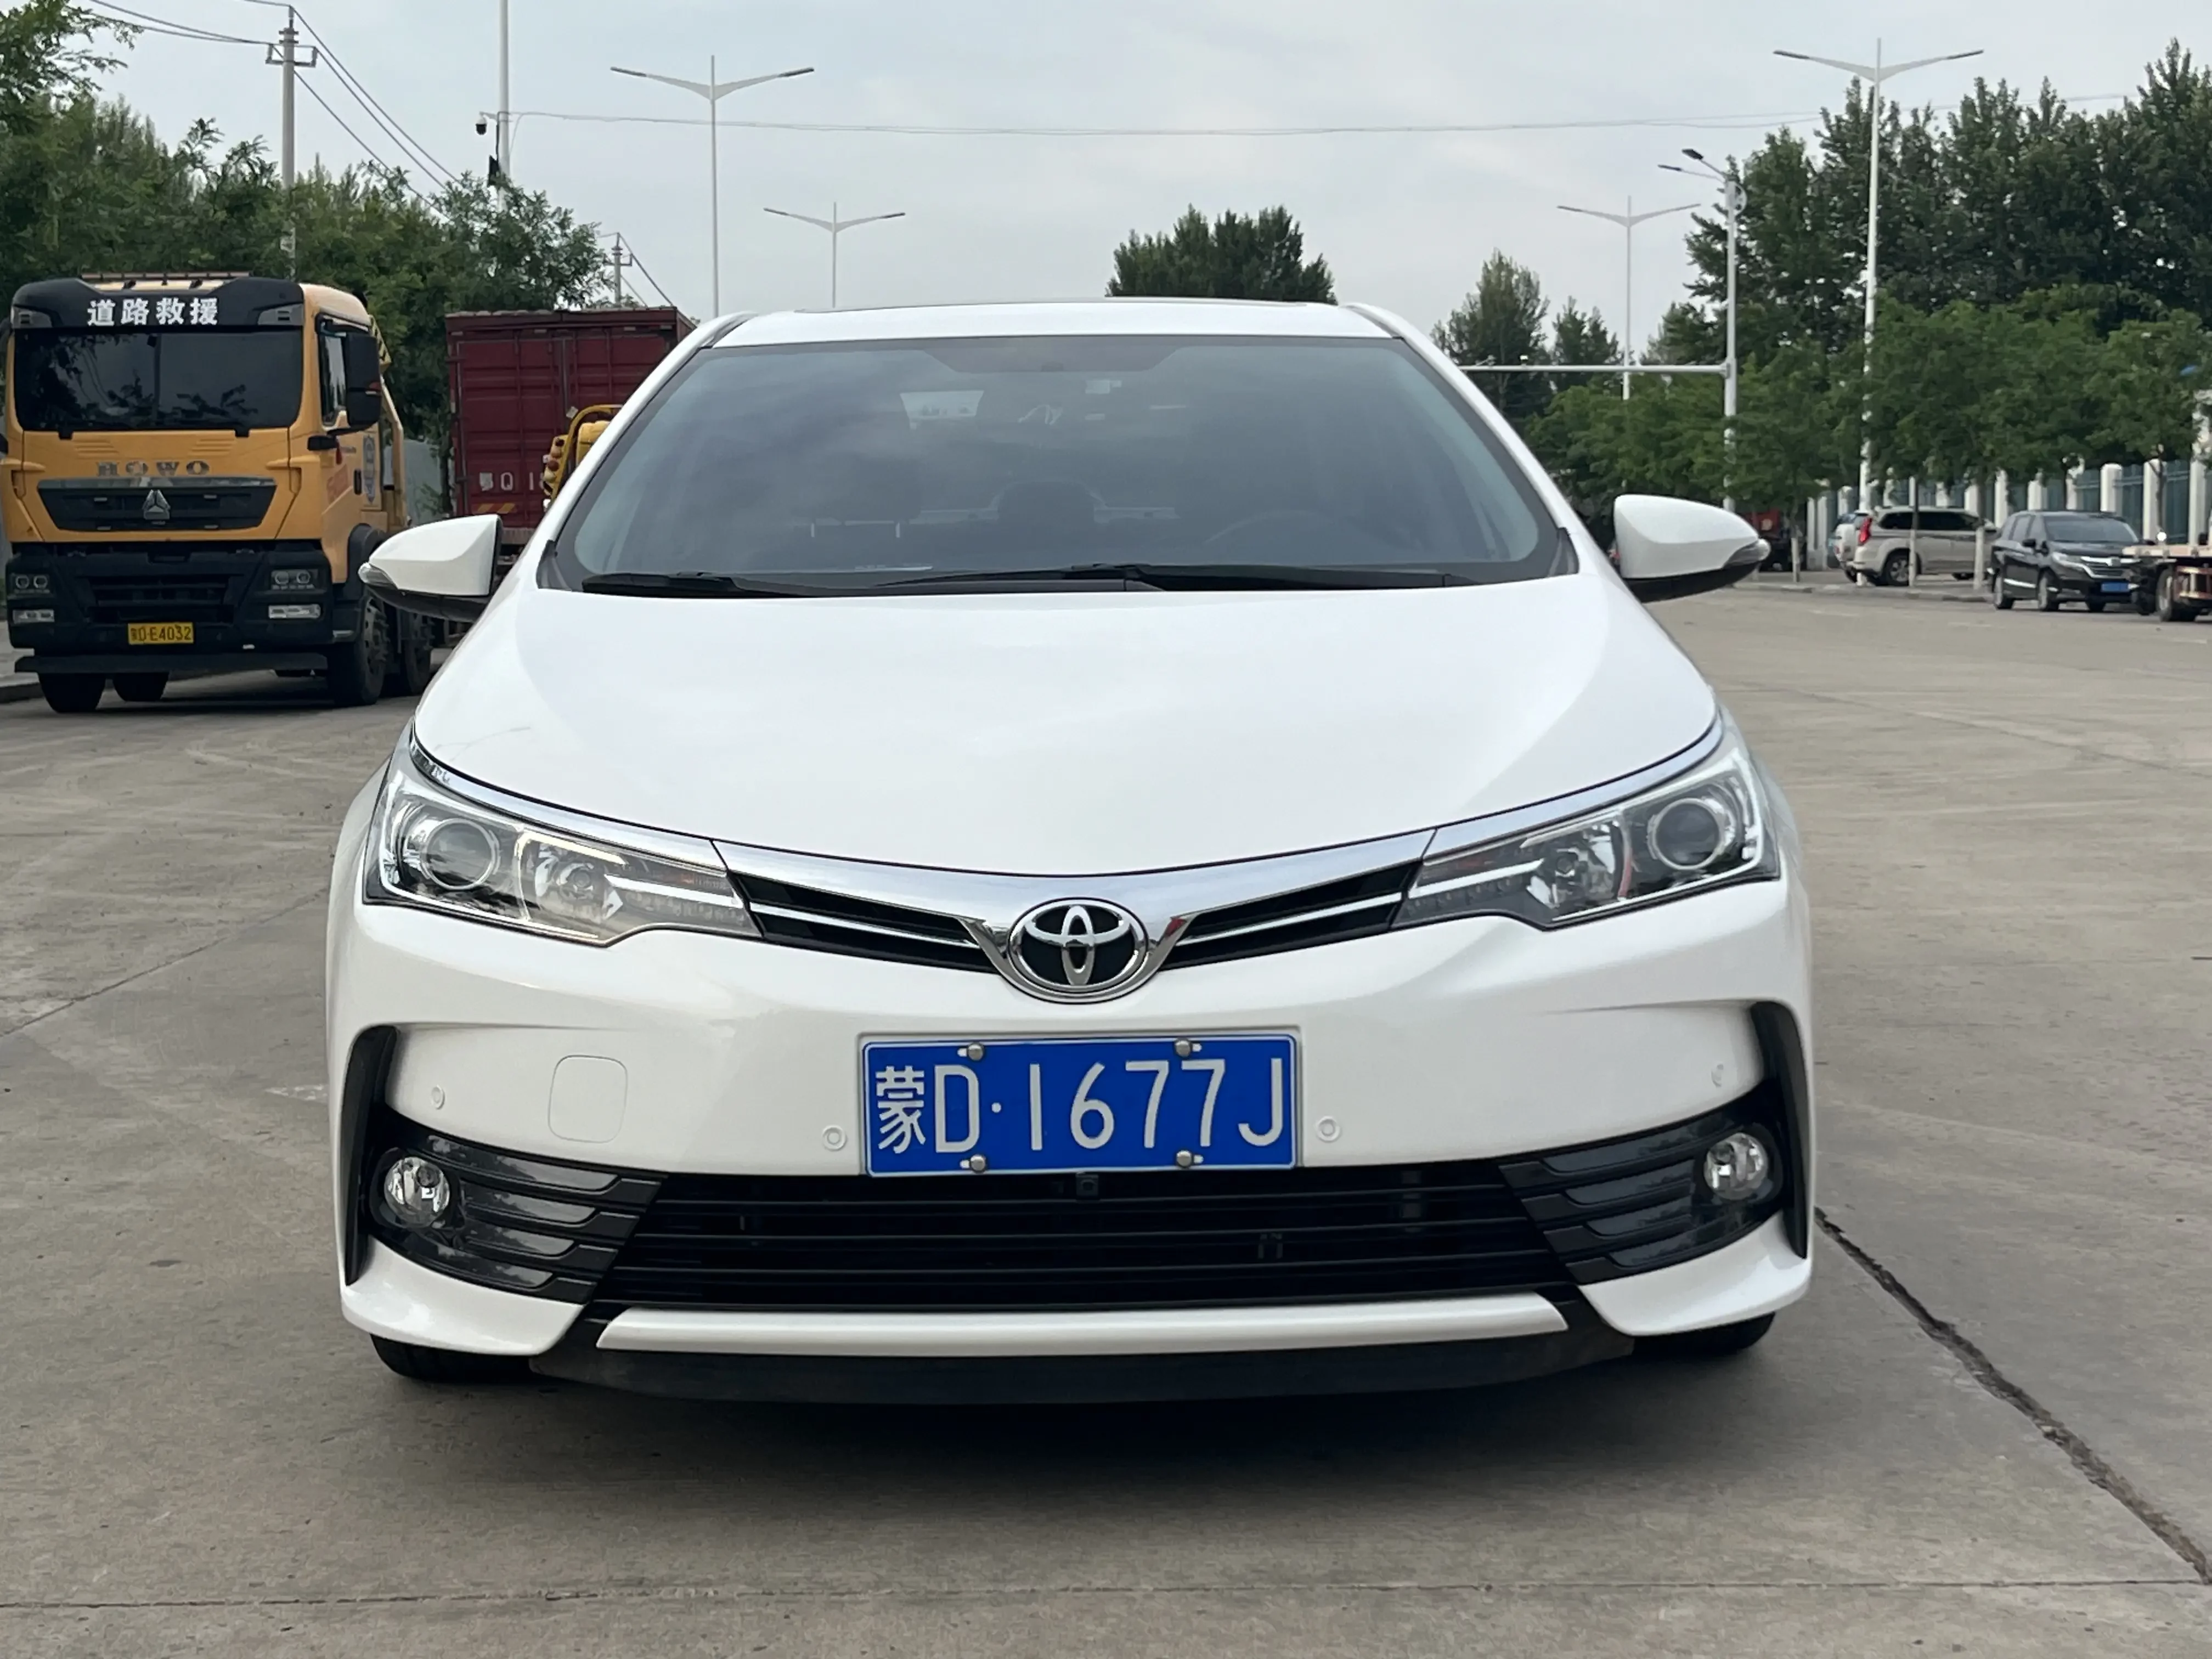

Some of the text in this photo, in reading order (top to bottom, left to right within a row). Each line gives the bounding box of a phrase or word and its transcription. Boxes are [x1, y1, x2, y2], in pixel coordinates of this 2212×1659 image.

[87, 297, 217, 326] 道路救援
[97, 460, 210, 477] HOWO
